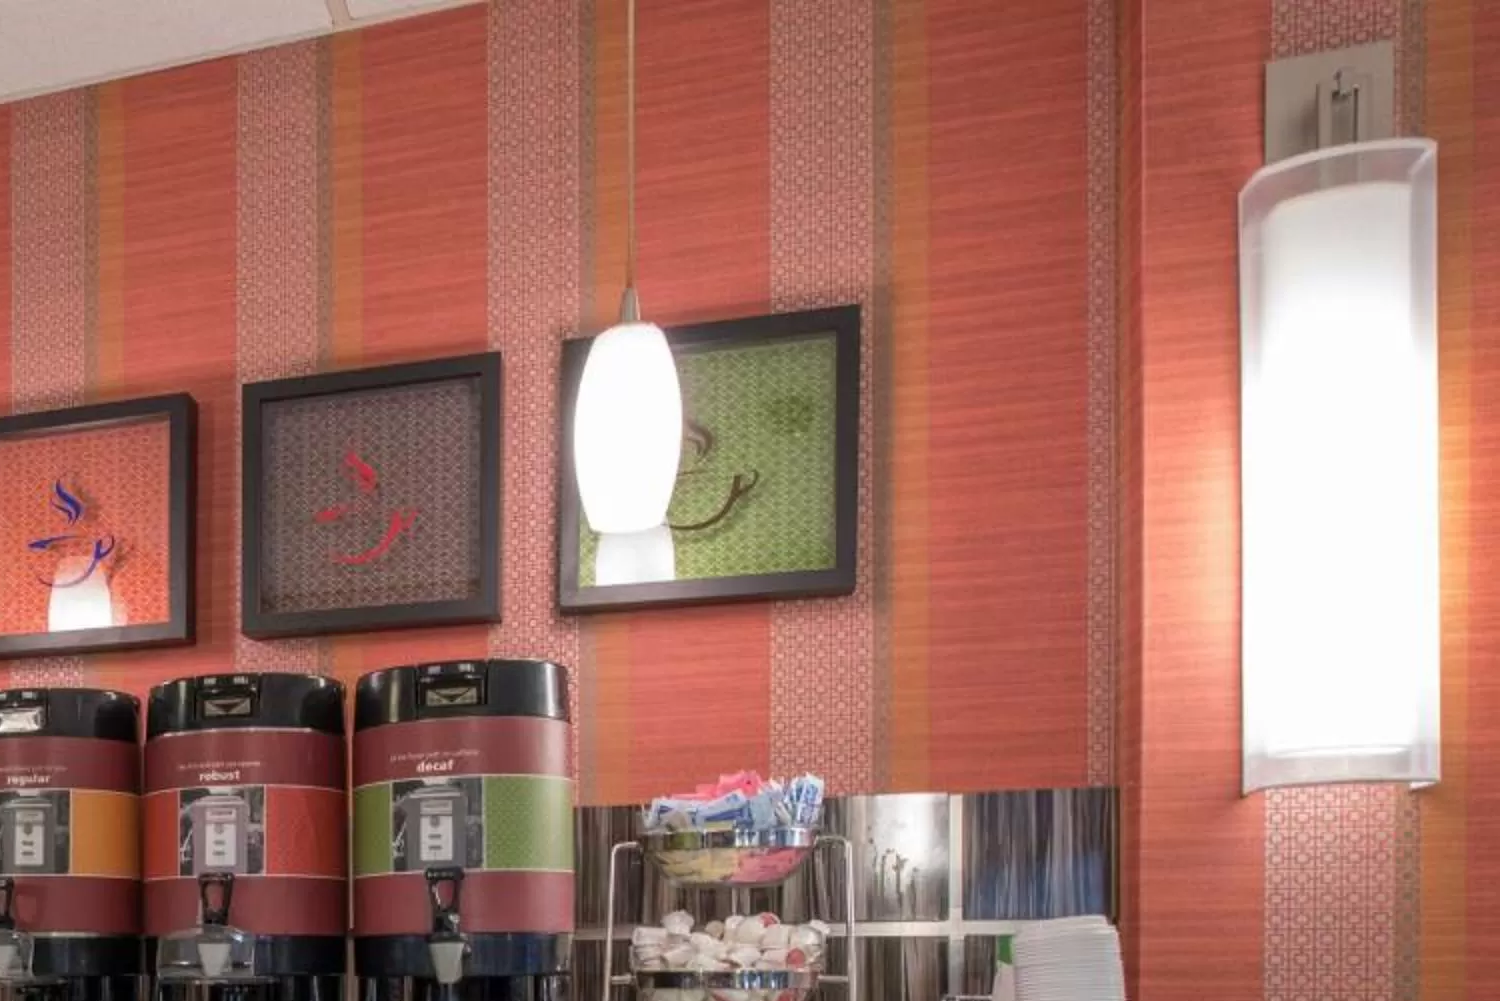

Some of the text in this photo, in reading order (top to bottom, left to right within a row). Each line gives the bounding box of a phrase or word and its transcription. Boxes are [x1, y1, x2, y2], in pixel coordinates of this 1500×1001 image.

[415, 759, 455, 772] decaf
[6, 774, 51, 786] regular
[199, 769, 240, 781] robust
